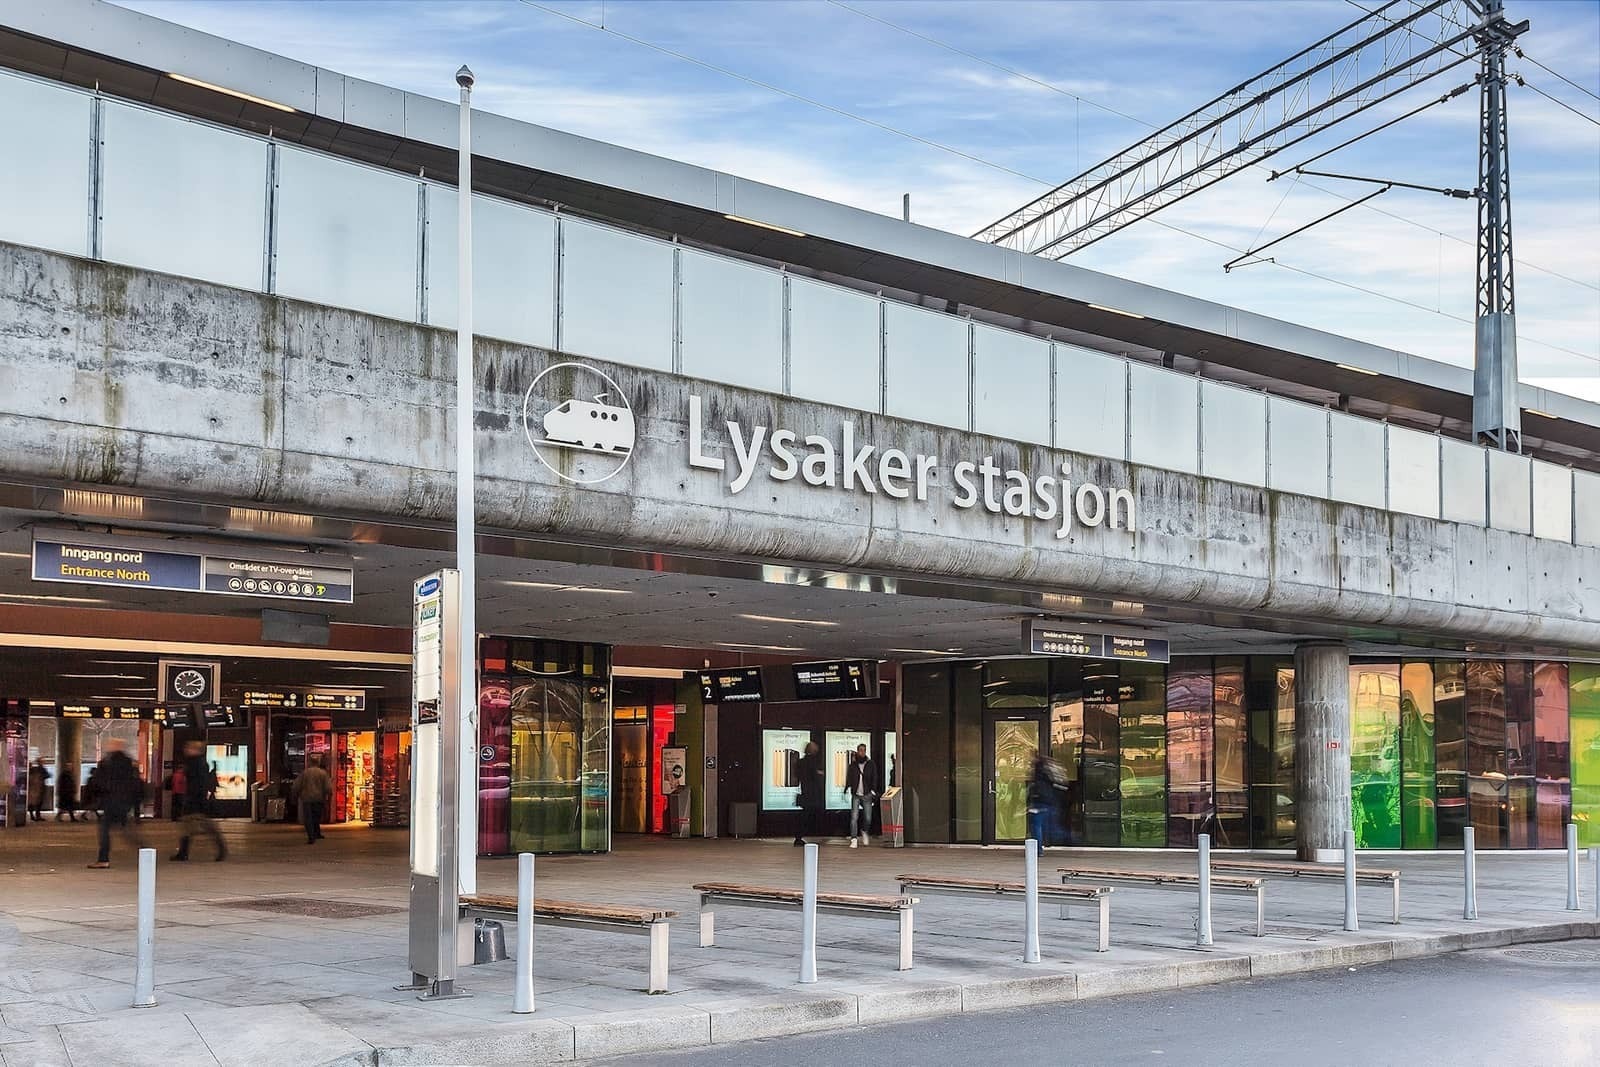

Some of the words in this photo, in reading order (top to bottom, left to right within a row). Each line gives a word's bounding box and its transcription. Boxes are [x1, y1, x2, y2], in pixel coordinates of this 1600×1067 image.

[689, 395, 937, 500] Lysaker
[953, 456, 1136, 539] stasjon
[61, 545, 112, 562] Inngang
[114, 552, 143, 564] nord
[61, 564, 114, 579] Entrance
[116, 569, 150, 582] North
[704, 686, 712, 698] 2
[852, 678, 858, 691] 1
